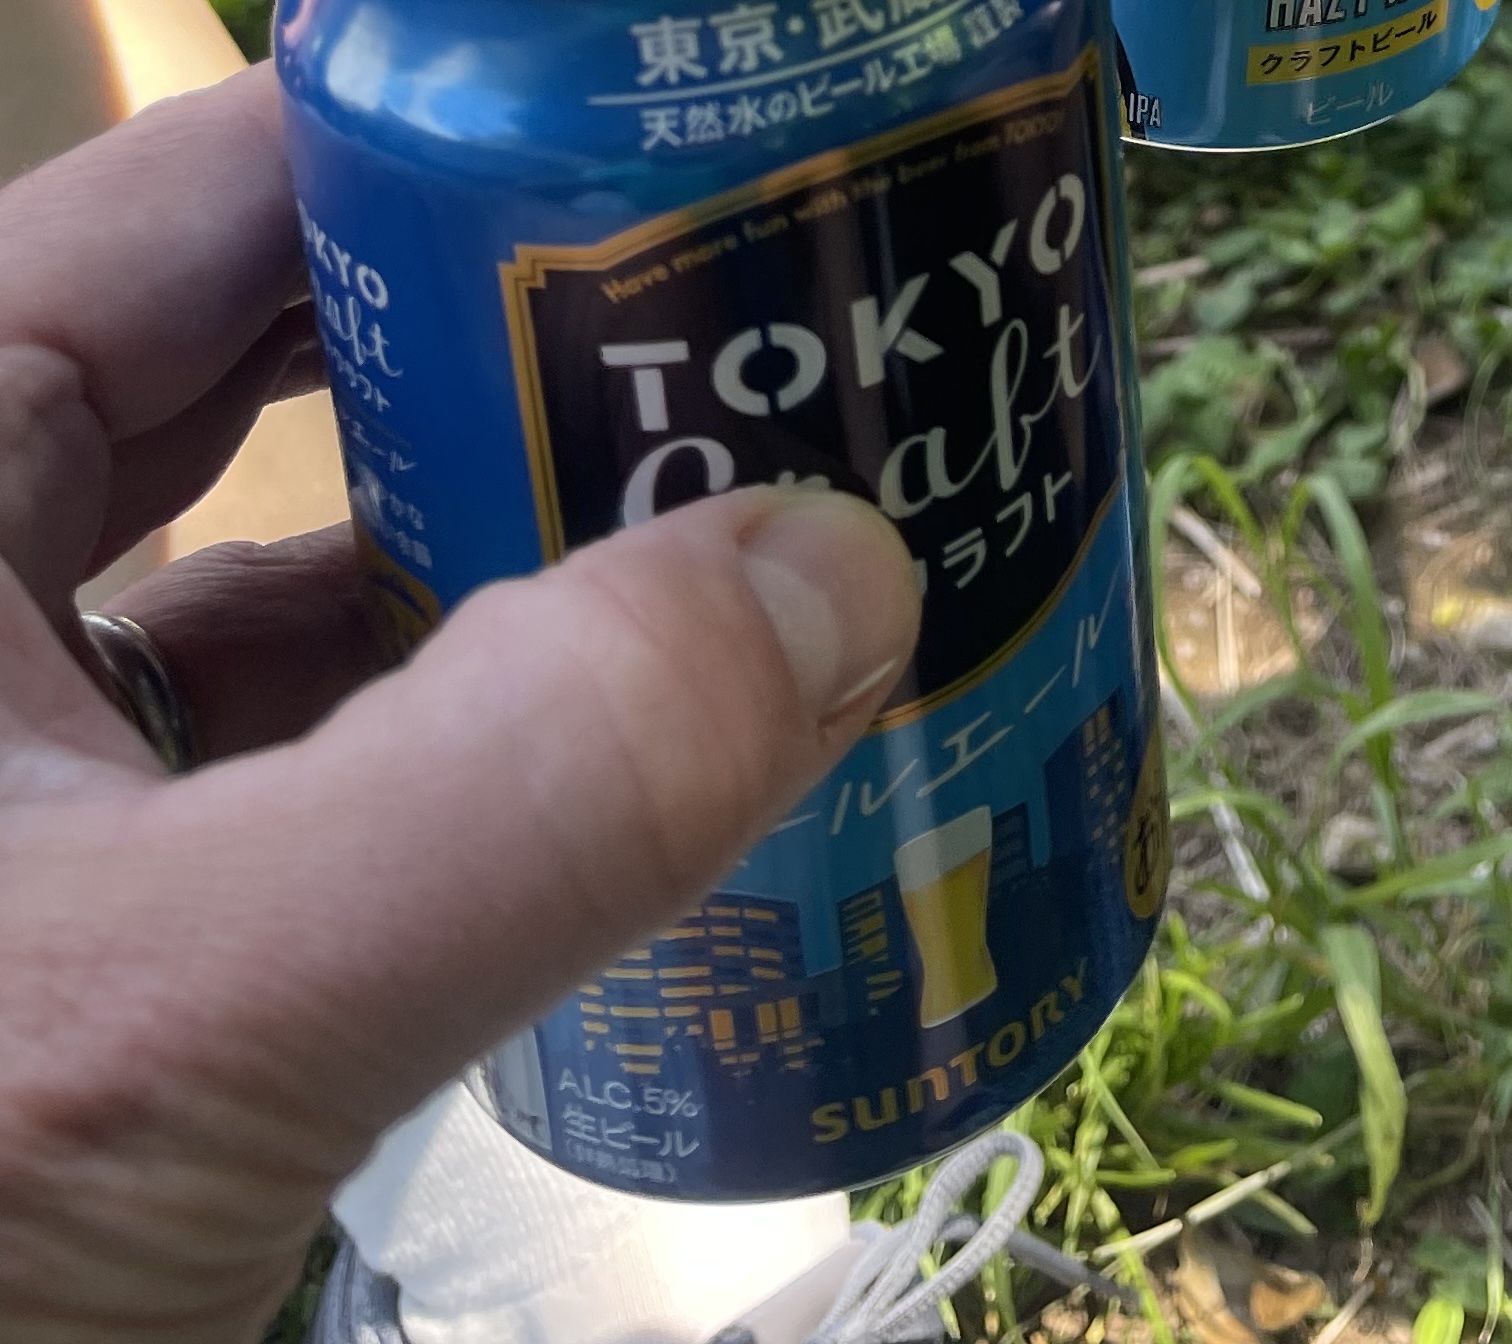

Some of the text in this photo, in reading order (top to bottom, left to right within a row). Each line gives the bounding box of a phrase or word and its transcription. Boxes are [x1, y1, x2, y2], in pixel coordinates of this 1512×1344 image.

[1260, 10, 1438, 76] クラフトビール
[1128, 92, 1162, 128] IPA
[1306, 79, 1394, 125] ビール
[601, 173, 1086, 432] TOKYO
[622, 304, 1102, 530] Caft
[916, 470, 1074, 595] ラフト
[809, 955, 1088, 1144] SUNTORY
[562, 1102, 700, 1158] 生ビール
